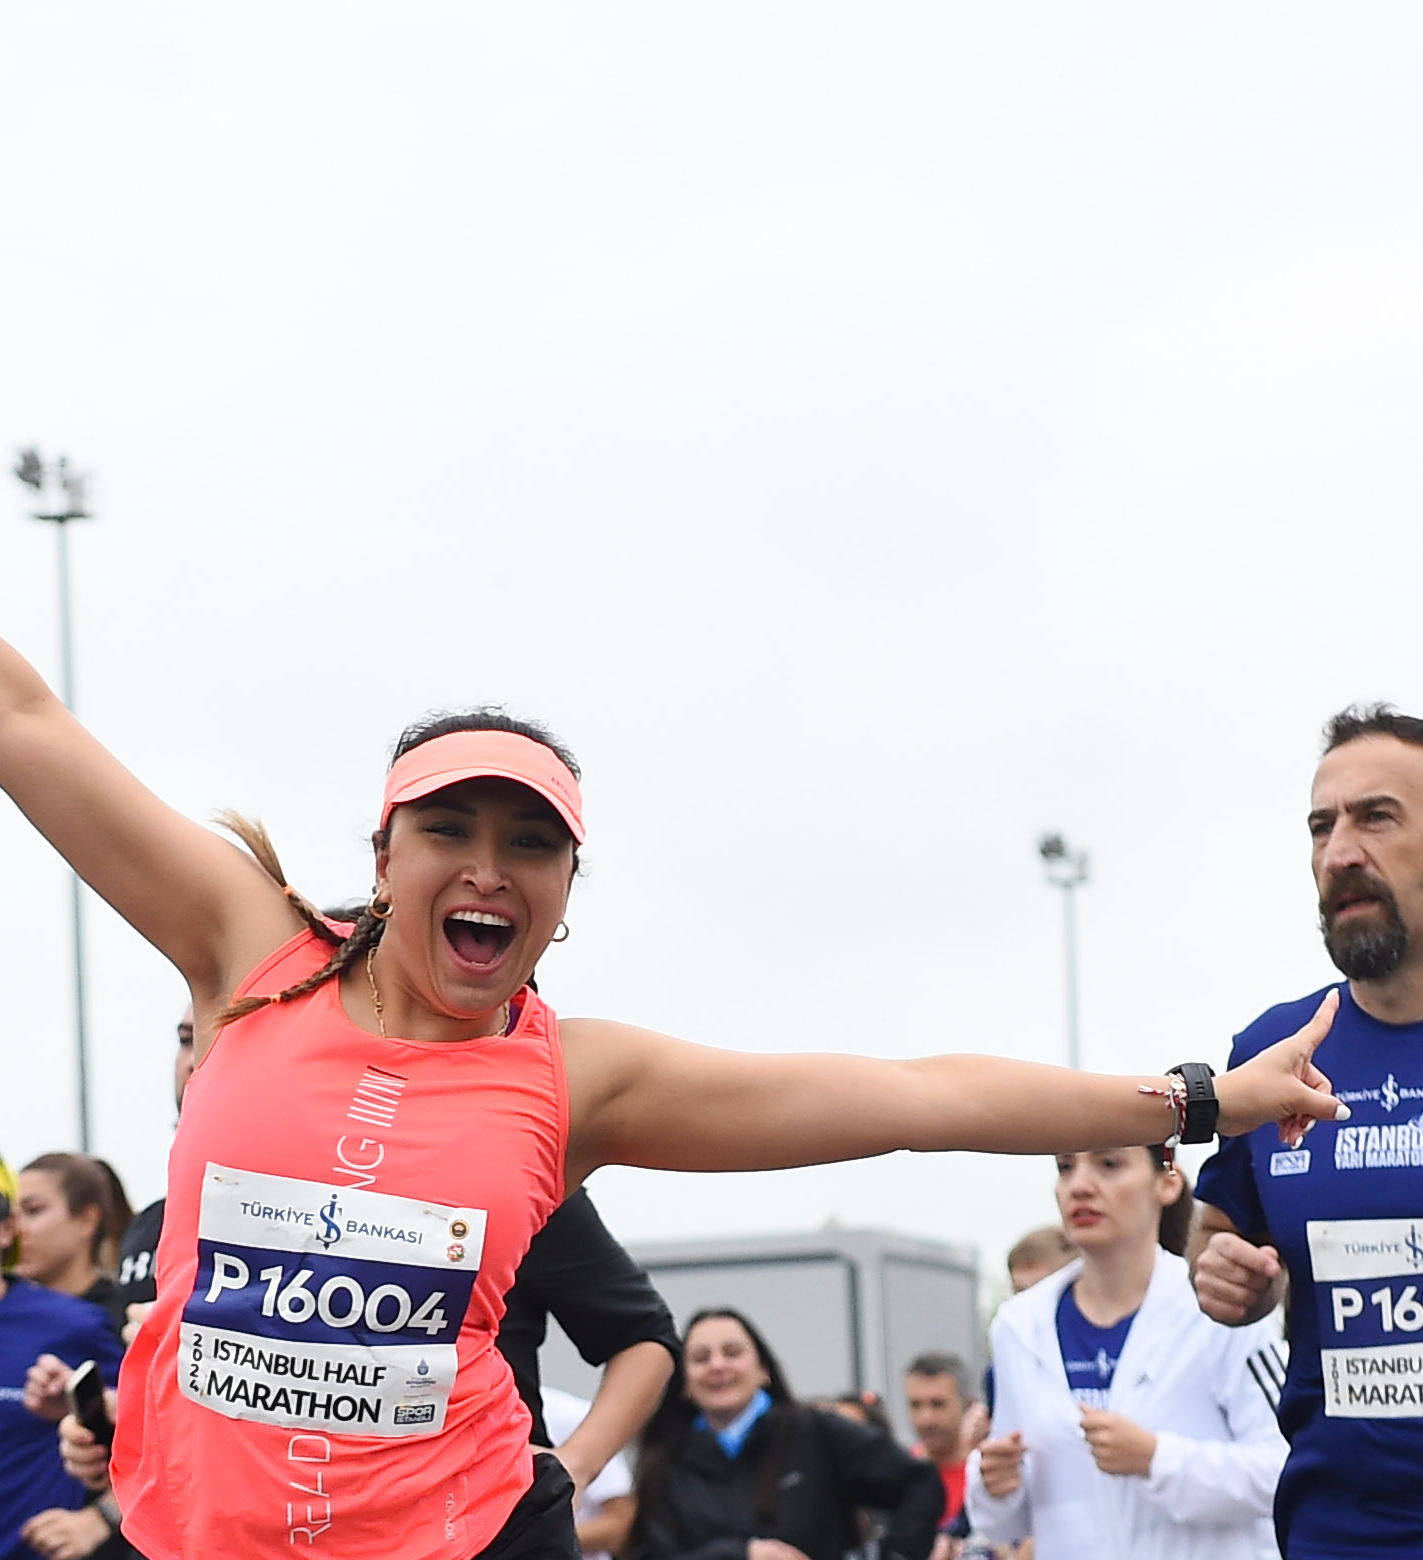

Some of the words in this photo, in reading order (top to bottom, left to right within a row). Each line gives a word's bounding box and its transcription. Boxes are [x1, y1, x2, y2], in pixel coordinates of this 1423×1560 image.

[240, 1201, 315, 1227] TÜRKİYE
[345, 1220, 424, 1245] BANKASI
[1344, 1242, 1401, 1255] TÜRKİYE
[204, 1251, 251, 1304] P
[259, 1265, 449, 1336] 16004
[1331, 1287, 1364, 1333] P
[213, 1338, 319, 1382] ISTANBUL
[323, 1361, 388, 1387] HALF
[206, 1369, 383, 1424] MARATHON
